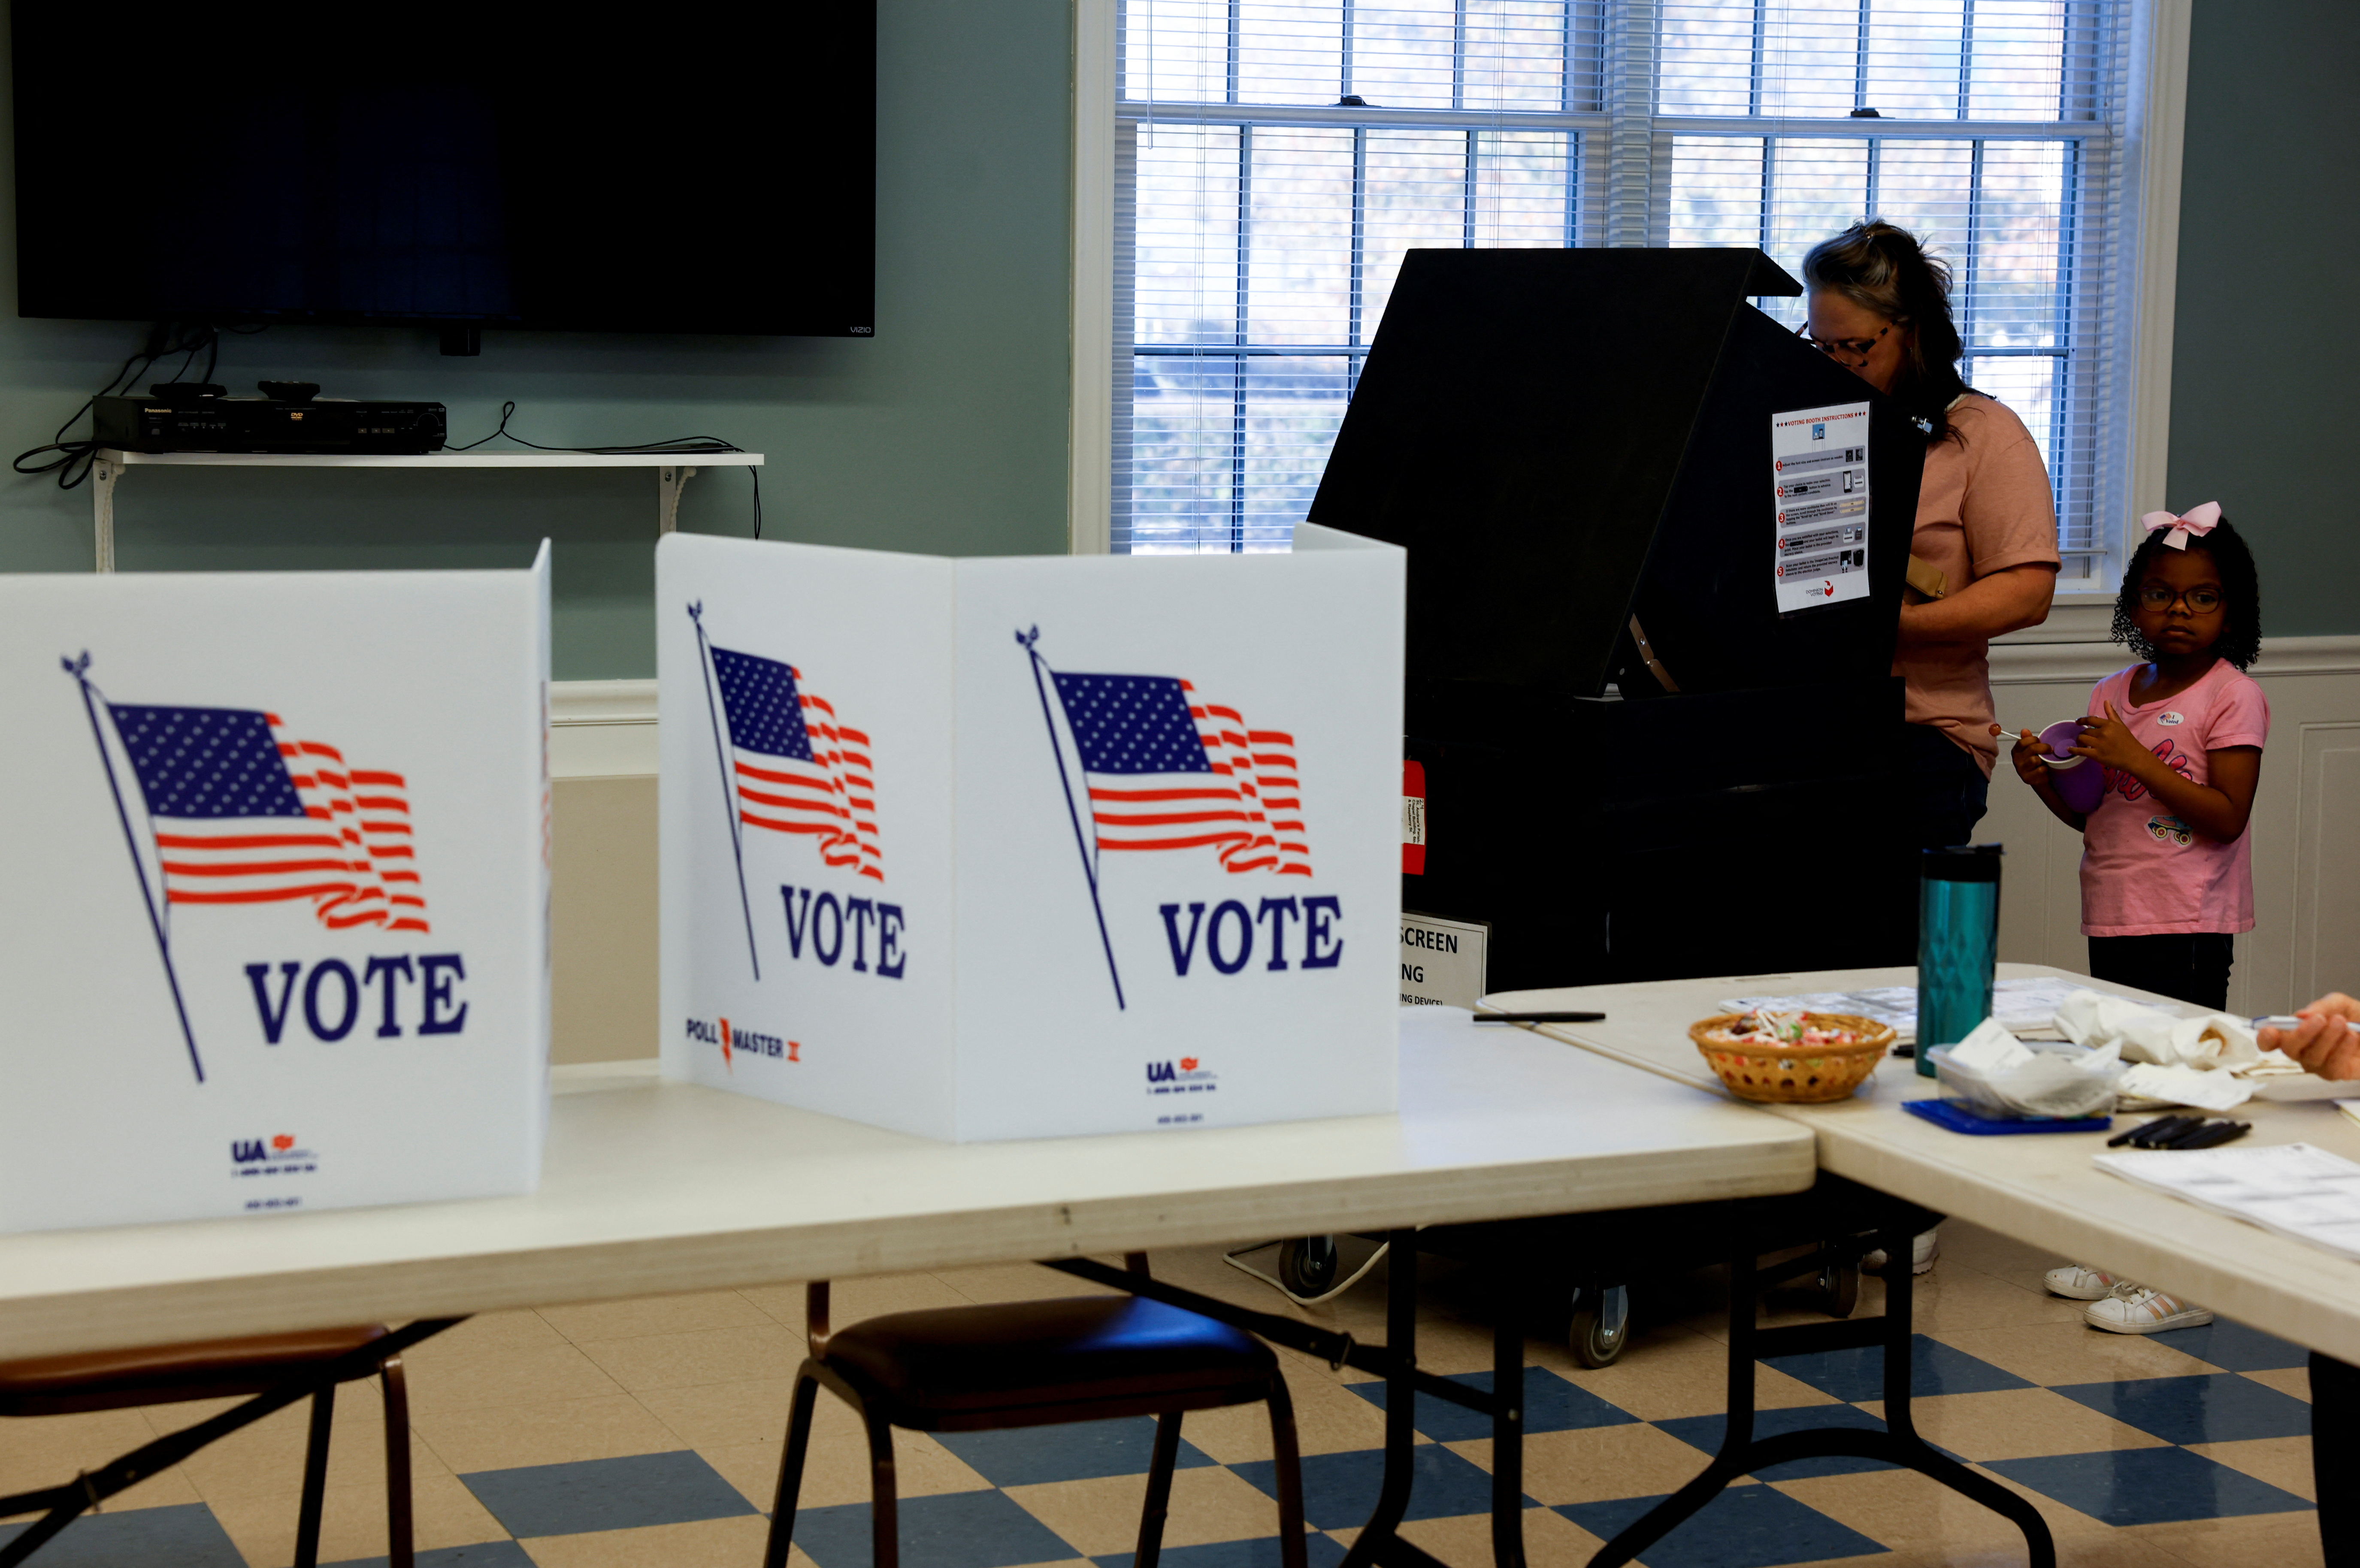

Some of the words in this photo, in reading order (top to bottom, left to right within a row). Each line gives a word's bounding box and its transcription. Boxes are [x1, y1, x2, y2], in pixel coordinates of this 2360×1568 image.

[1821, 413, 1853, 422] INSTRUCTIONS
[781, 884, 906, 980] VOTE
[1159, 894, 1343, 976] VOTE
[1400, 964, 1423, 983] NG
[243, 952, 469, 1045] VOTE
[686, 1018, 719, 1045] POLL
[732, 1028, 784, 1059] MASTER
[1147, 1059, 1176, 1082] UA
[231, 1139, 266, 1163] UA
